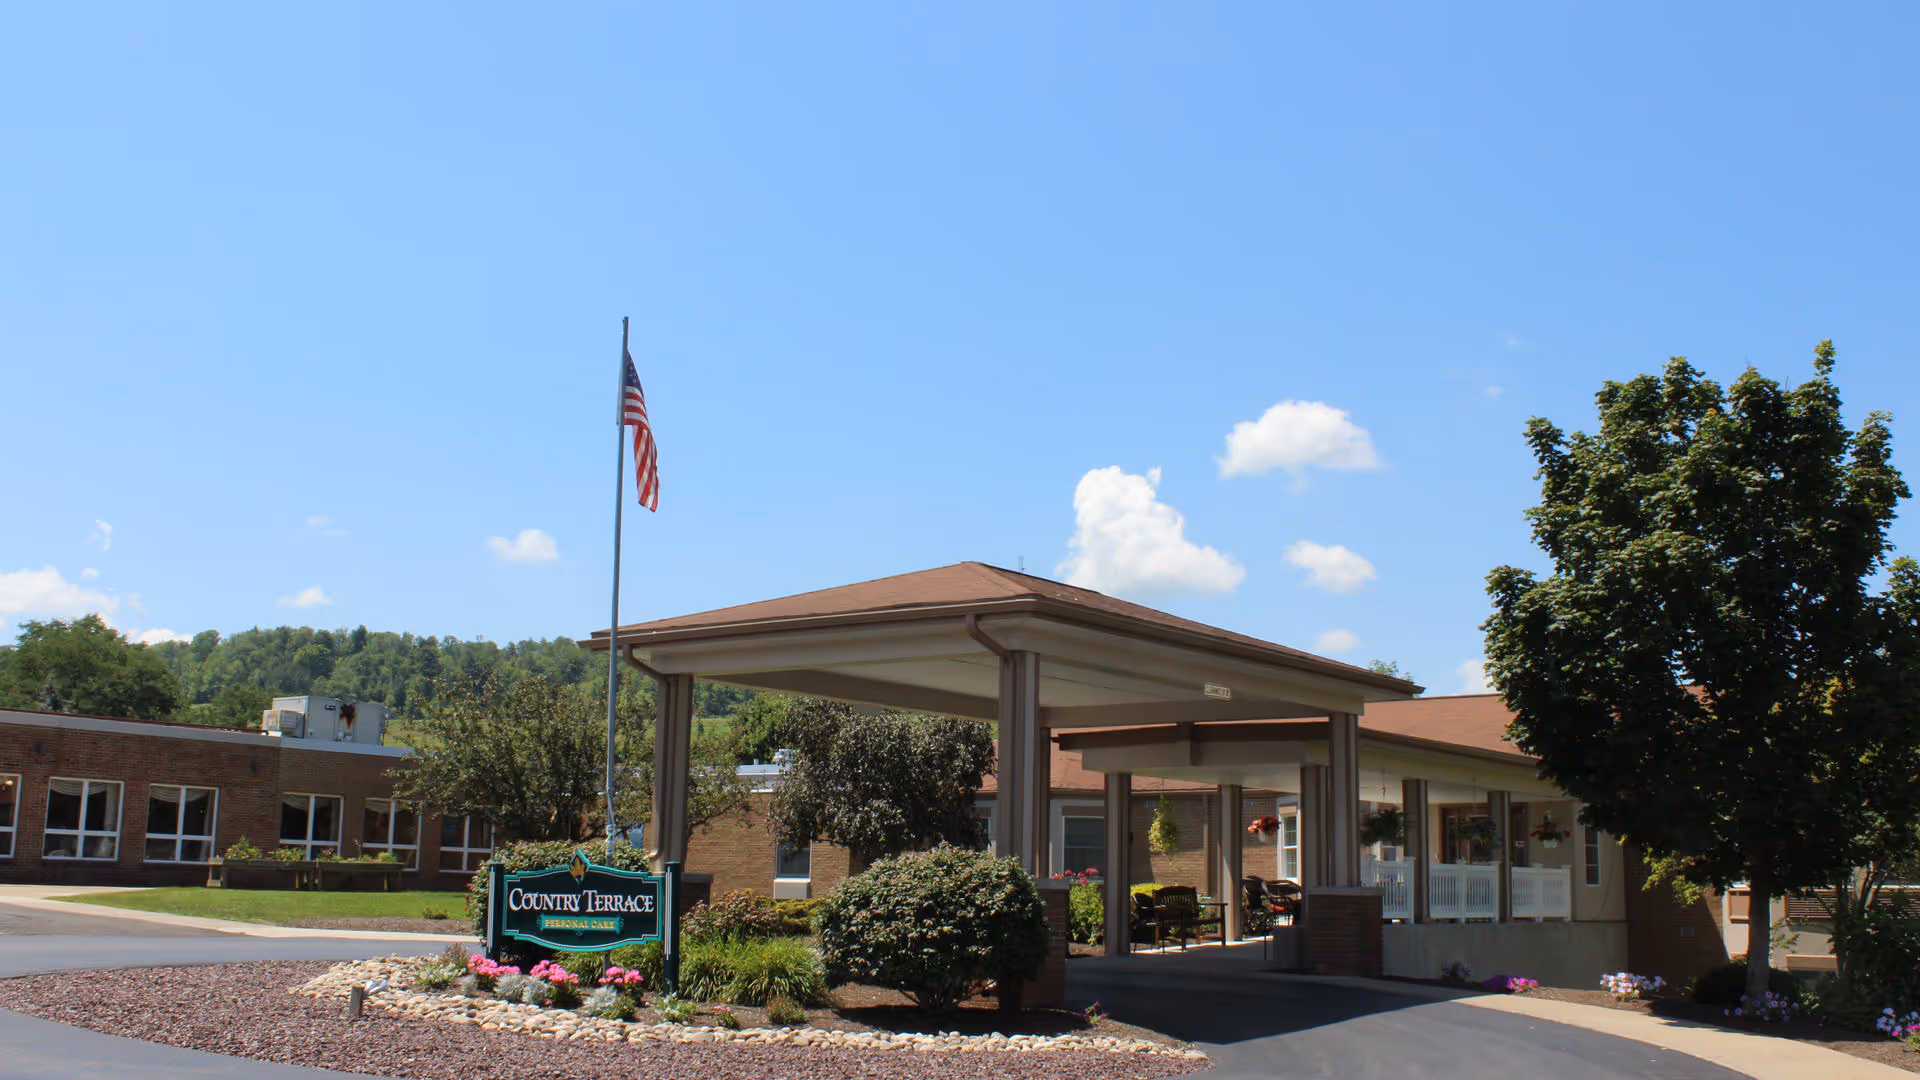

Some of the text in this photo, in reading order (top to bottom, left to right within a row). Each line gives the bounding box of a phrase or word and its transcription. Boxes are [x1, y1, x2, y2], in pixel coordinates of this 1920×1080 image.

[509, 888, 654, 912] COUNTRY TERRACE
[545, 919, 615, 929] PERSONAL CARE
